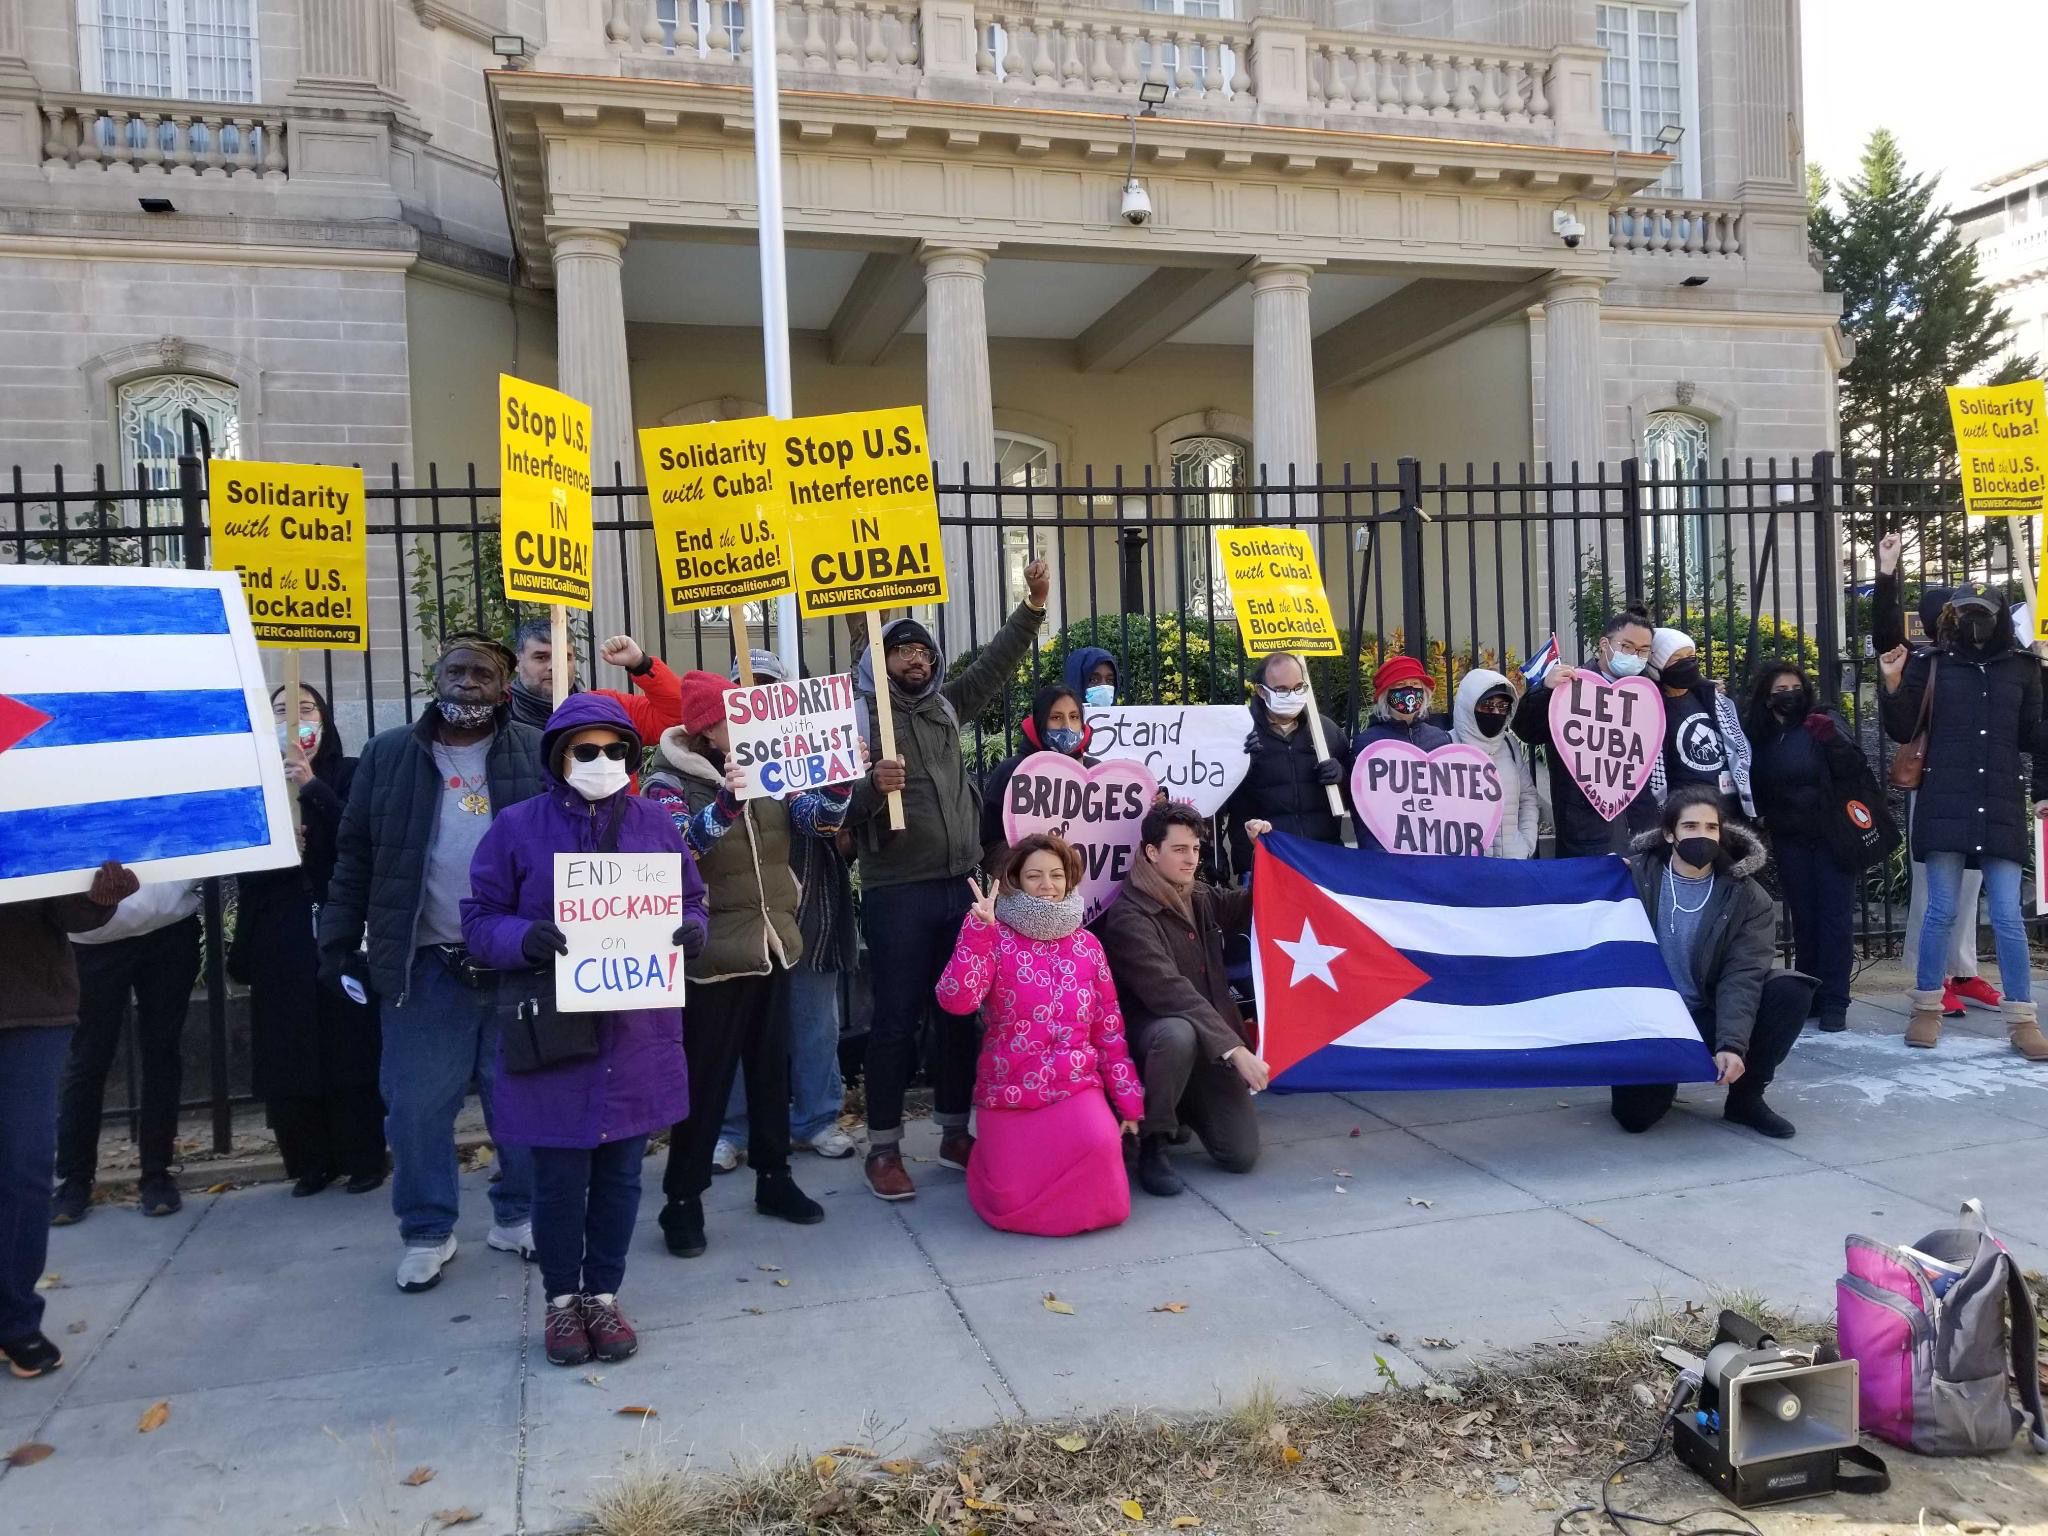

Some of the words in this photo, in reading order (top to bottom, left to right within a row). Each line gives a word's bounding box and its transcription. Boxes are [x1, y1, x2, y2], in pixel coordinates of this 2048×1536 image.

[1959, 398, 2034, 416] Solidarity
[507, 397, 556, 446] Stop
[562, 412, 588, 454] U.S.
[1963, 421, 1989, 438] with
[1992, 418, 2039, 438] Cuba!
[659, 439, 767, 471] Solidarity
[785, 436, 854, 469] Stop
[863, 426, 921, 459] U.S.
[507, 444, 590, 493] Interference
[1972, 457, 1995, 473] End
[2009, 456, 2040, 474] U.S.
[227, 480, 350, 515] Solidarity
[662, 476, 705, 504] with
[713, 469, 773, 498] Cuba!
[790, 473, 929, 505] Interference
[1973, 474, 2046, 493] Blockade!
[224, 515, 271, 538] with
[280, 516, 352, 542] Cuba!
[550, 501, 568, 531] IN
[851, 517, 880, 543] IN
[675, 528, 713, 552] End
[719, 528, 736, 548] the
[740, 519, 775, 545] U.S.
[514, 530, 588, 577] CUBA!
[676, 544, 781, 580] Blockade!
[811, 543, 931, 585] CUBA!
[1230, 541, 1304, 561] Solidarity
[234, 565, 272, 588] End
[279, 570, 298, 590] the
[305, 568, 347, 591] U.S.
[513, 572, 589, 599] ANSWERCoalition.org
[1235, 562, 1265, 579] with
[1269, 562, 1313, 580] Cuba!
[676, 576, 786, 601] ANSWERCoalition.org
[811, 582, 936, 605] ANSWERCoalition.org
[248, 594, 352, 619] lockade!
[1247, 598, 1275, 615] End
[1279, 599, 1290, 613] the
[1293, 597, 1319, 614] U.S.
[254, 625, 356, 641] WERCoalition.org
[1249, 617, 1327, 634] Blockade!
[1253, 639, 1333, 650] ANSWERCoalition.org
[1570, 678, 1639, 728] LET
[780, 718, 814, 735] with
[1085, 711, 1185, 757] Stand
[1563, 720, 1645, 765] CUBA
[760, 750, 858, 793] CUBA!
[1145, 749, 1225, 787] Cuba
[1367, 757, 1503, 802] PUENTES
[1575, 752, 1637, 790] LIVE
[1010, 773, 1143, 823] BRIDGES
[1401, 795, 1434, 813] de
[1393, 813, 1485, 857] AMOR
[567, 860, 622, 888] END
[632, 863, 669, 884] the
[1069, 842, 1132, 882] OVE
[558, 895, 682, 923] BLOCKADE
[601, 936, 626, 950] on
[574, 952, 678, 993] CUBA!
